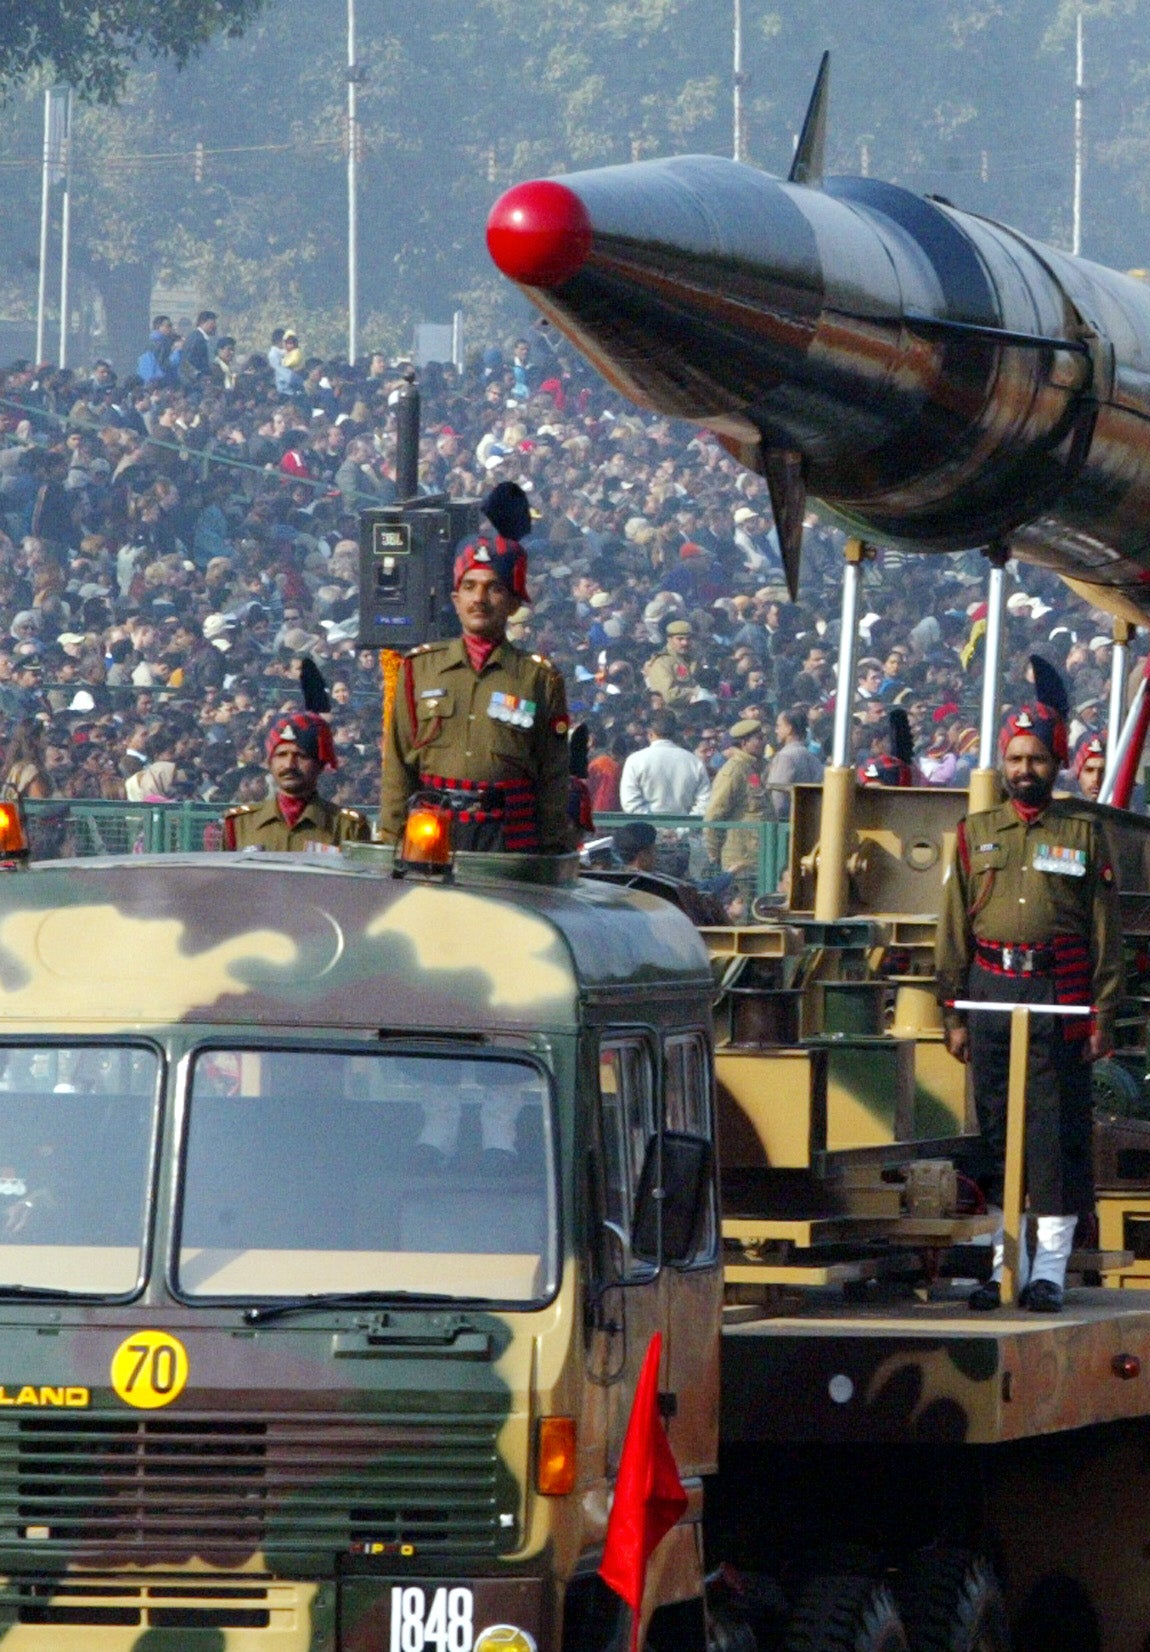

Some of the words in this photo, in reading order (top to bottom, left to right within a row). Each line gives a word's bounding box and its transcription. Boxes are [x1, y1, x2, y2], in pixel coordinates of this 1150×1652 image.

[125, 1345, 177, 1394] 70
[0, 1385, 89, 1407] LAND
[350, 1542, 415, 1556] IPO
[390, 1587, 473, 1652] 1848
